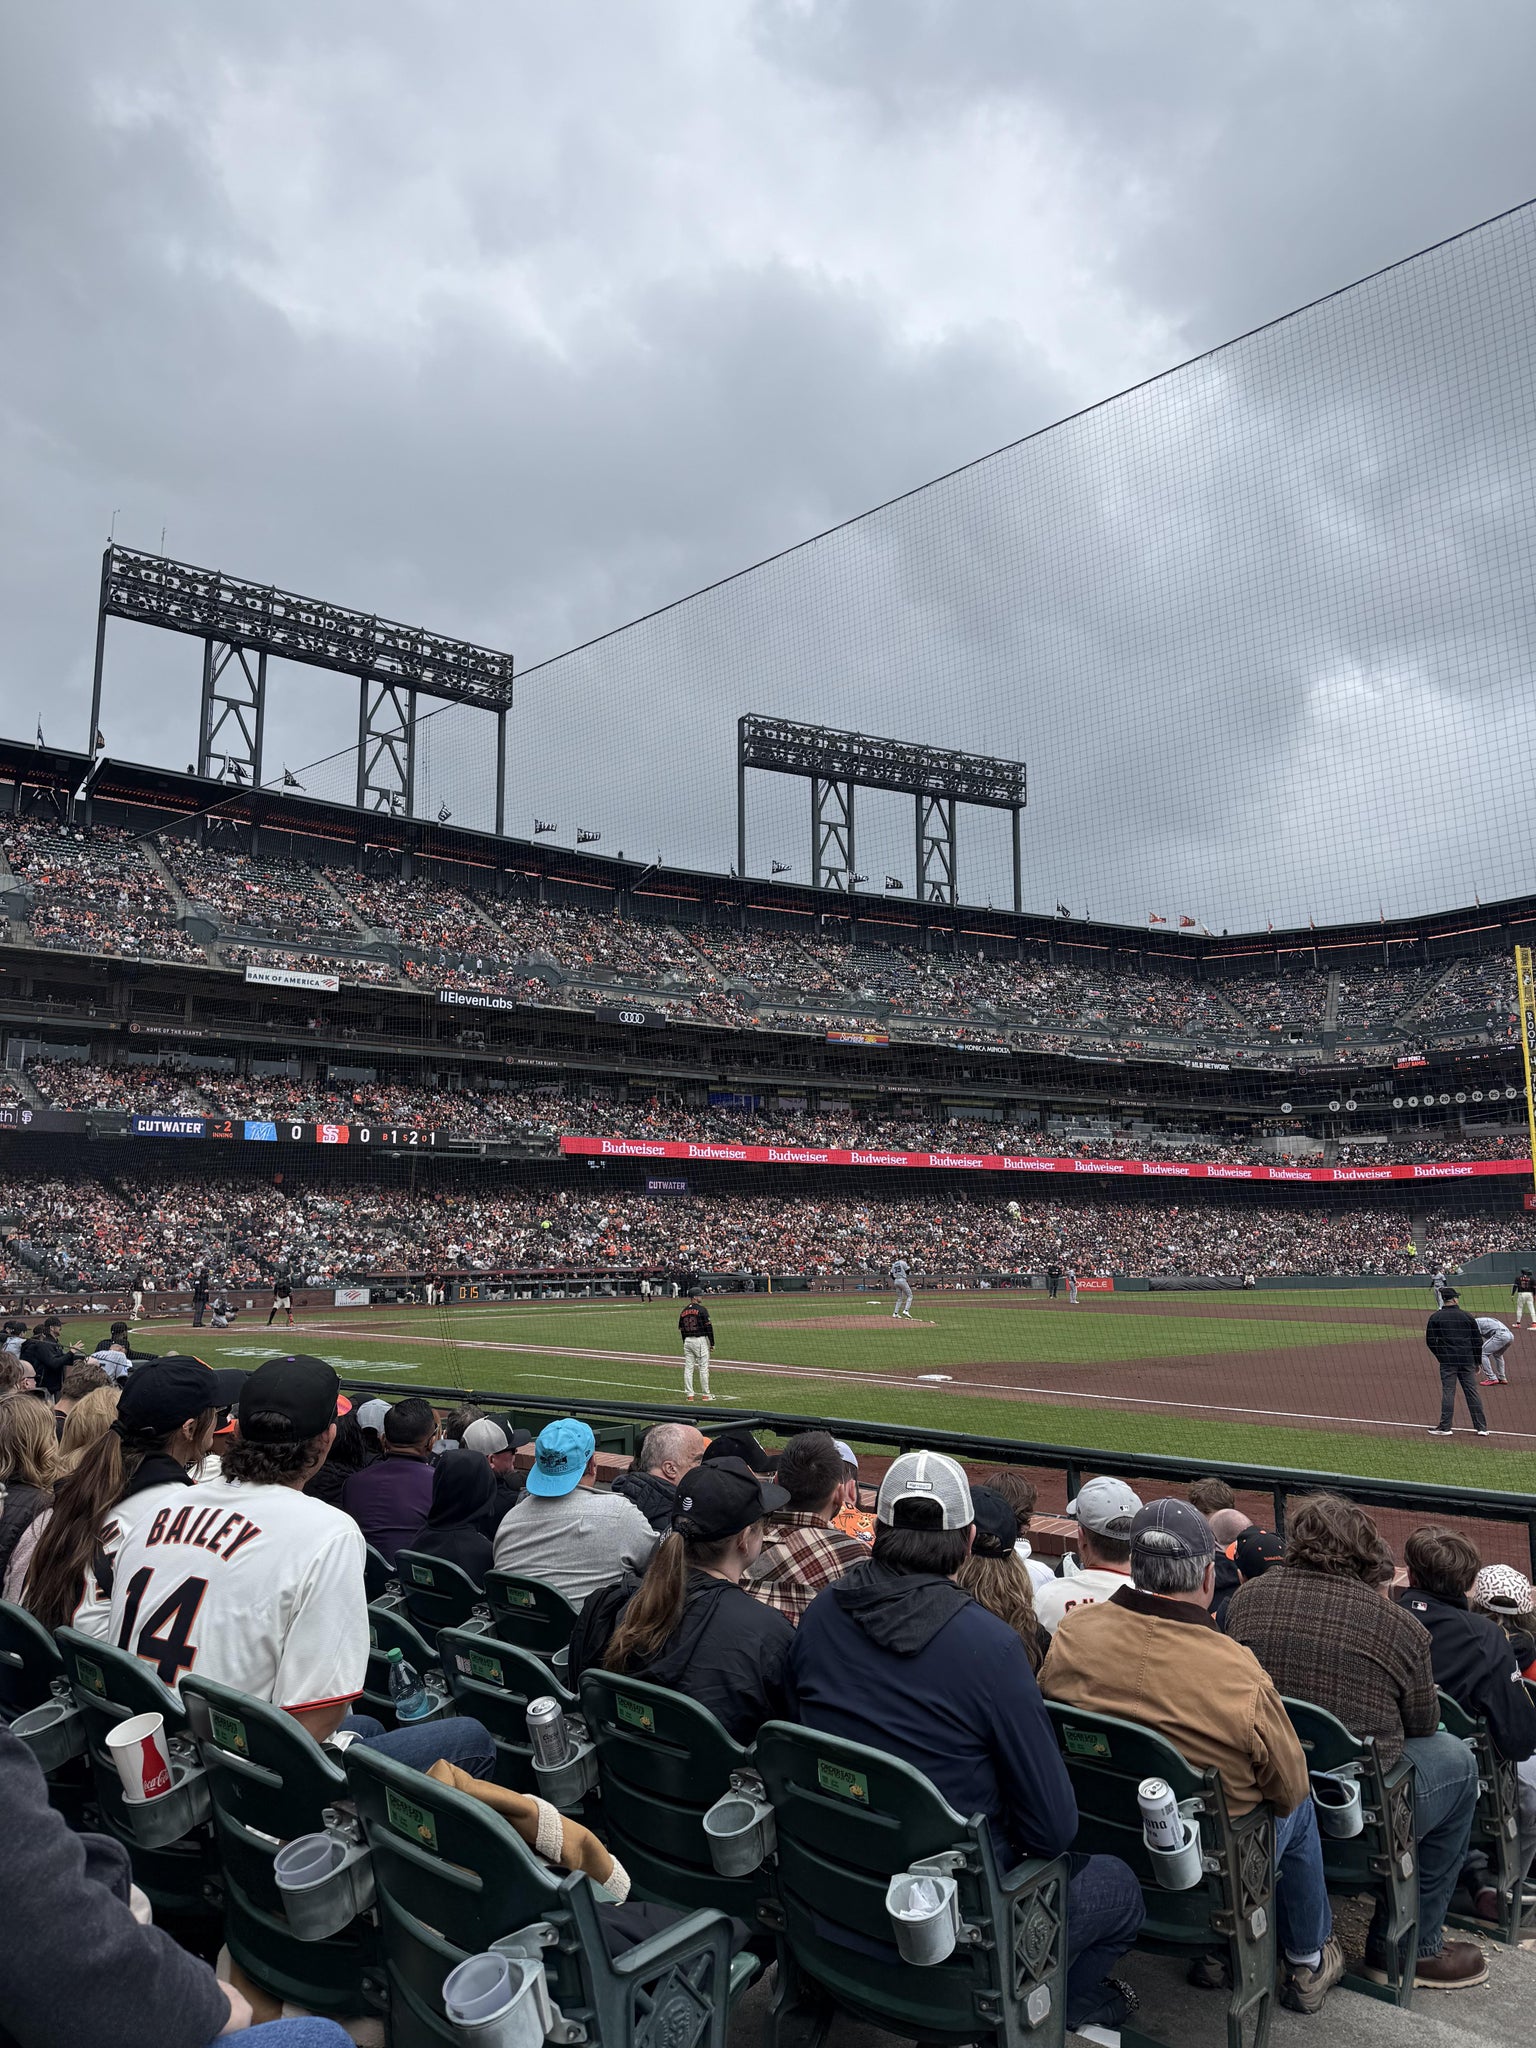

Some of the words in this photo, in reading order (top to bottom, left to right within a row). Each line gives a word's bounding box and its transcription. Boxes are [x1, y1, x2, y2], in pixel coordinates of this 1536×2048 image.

[247, 972, 269, 981] BANK
[285, 976, 320, 987] AMERICA
[1527, 1011, 1536, 1048] ROOT
[965, 1043, 986, 1052] KONICA
[987, 1045, 1010, 1054] MINOLTA
[138, 1120, 201, 1134] CUTWATER
[224, 1121, 232, 1132] 2
[292, 1126, 302, 1139] 0
[361, 1129, 370, 1142] 0
[391, 1131, 397, 1143] 1
[409, 1131, 418, 1145] 2
[429, 1132, 435, 1145] 1
[648, 1181, 685, 1190] CUTWATER
[146, 1506, 262, 1562] BAILEY
[118, 1566, 209, 1688] 14
